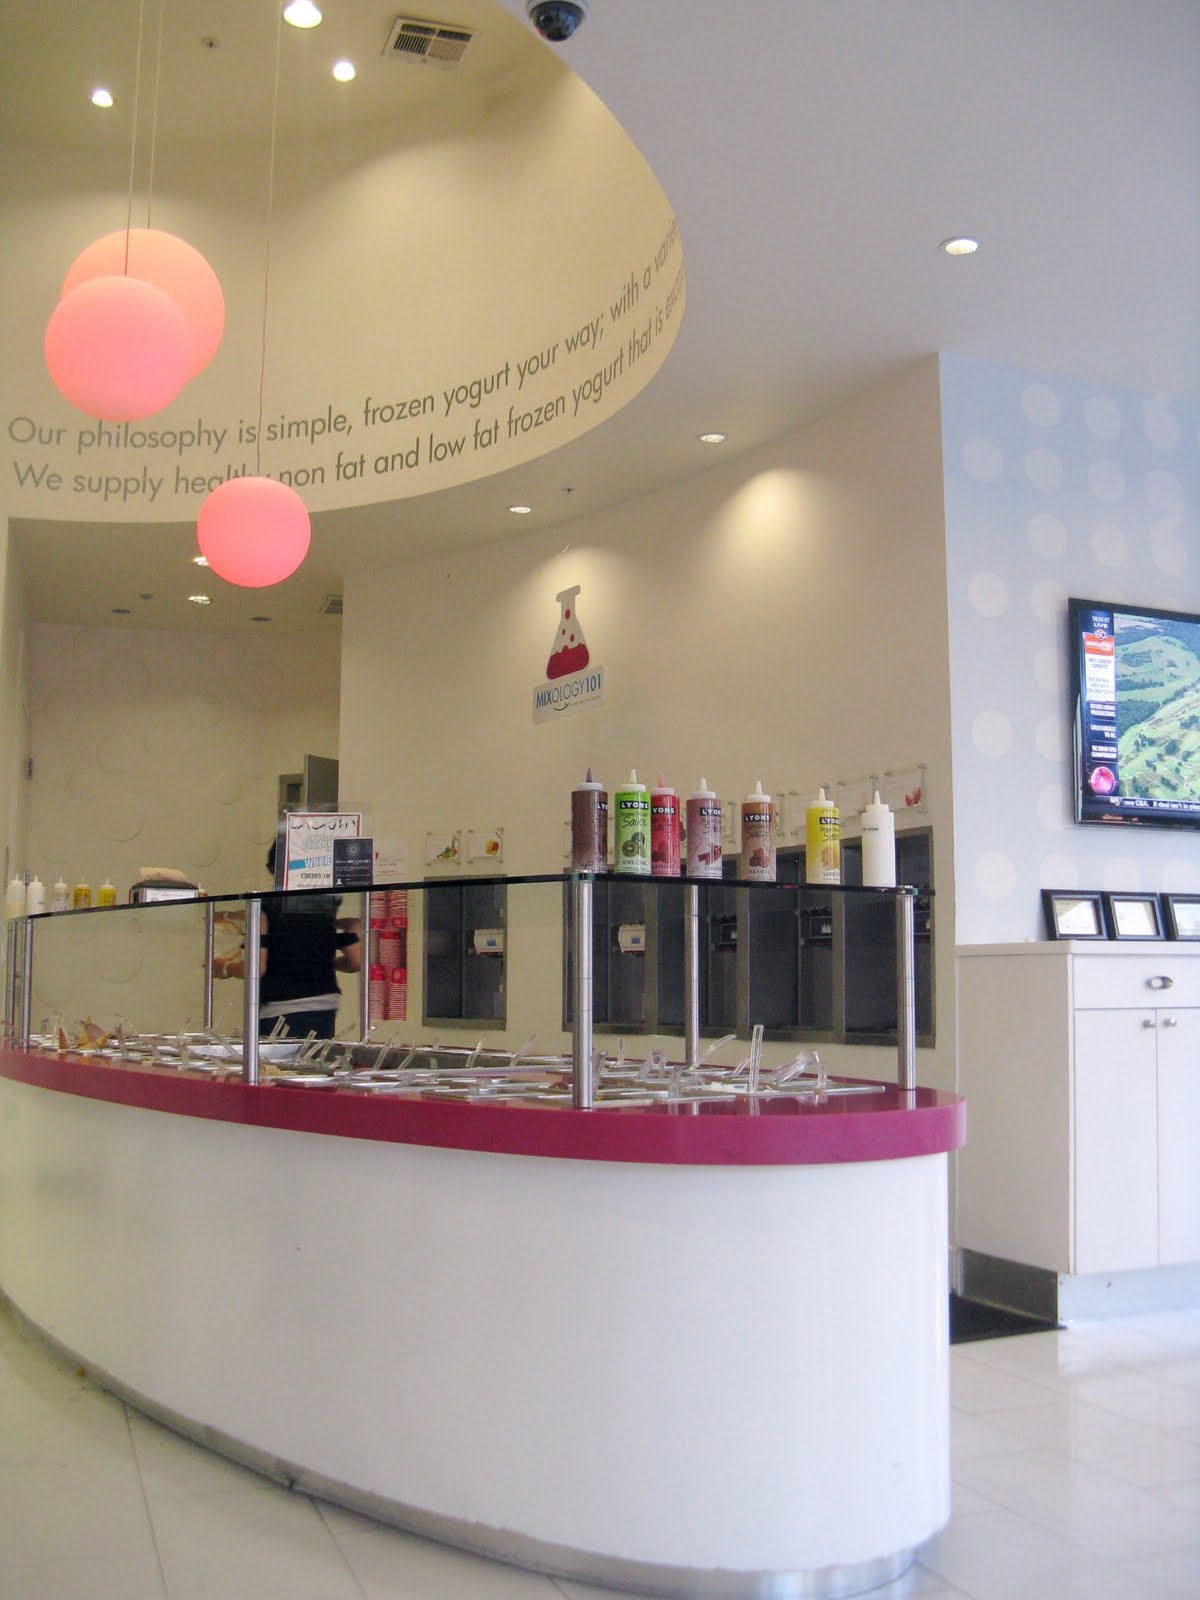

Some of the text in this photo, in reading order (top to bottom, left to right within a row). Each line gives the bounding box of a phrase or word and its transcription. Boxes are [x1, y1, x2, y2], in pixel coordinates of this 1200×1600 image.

[9, 416, 67, 445] Our
[77, 418, 227, 455] philosophy
[238, 420, 257, 444] is
[266, 404, 352, 444] simple,
[363, 394, 435, 427] frozen
[443, 362, 510, 416] yogurt
[516, 343, 559, 390] your
[565, 313, 604, 354] way;
[609, 271, 639, 323] with
[643, 265, 651, 290] a
[13, 461, 63, 491] We
[73, 465, 164, 502] supply
[280, 466, 325, 488] non
[336, 452, 366, 481] fat
[373, 437, 419, 475] and
[428, 433, 466, 463] low
[473, 419, 500, 450] fat
[507, 395, 566, 439] frozen
[572, 347, 624, 416] yogurt
[628, 318, 652, 368] that
[655, 305, 663, 336] is
[621, 801, 648, 809] LYONS
